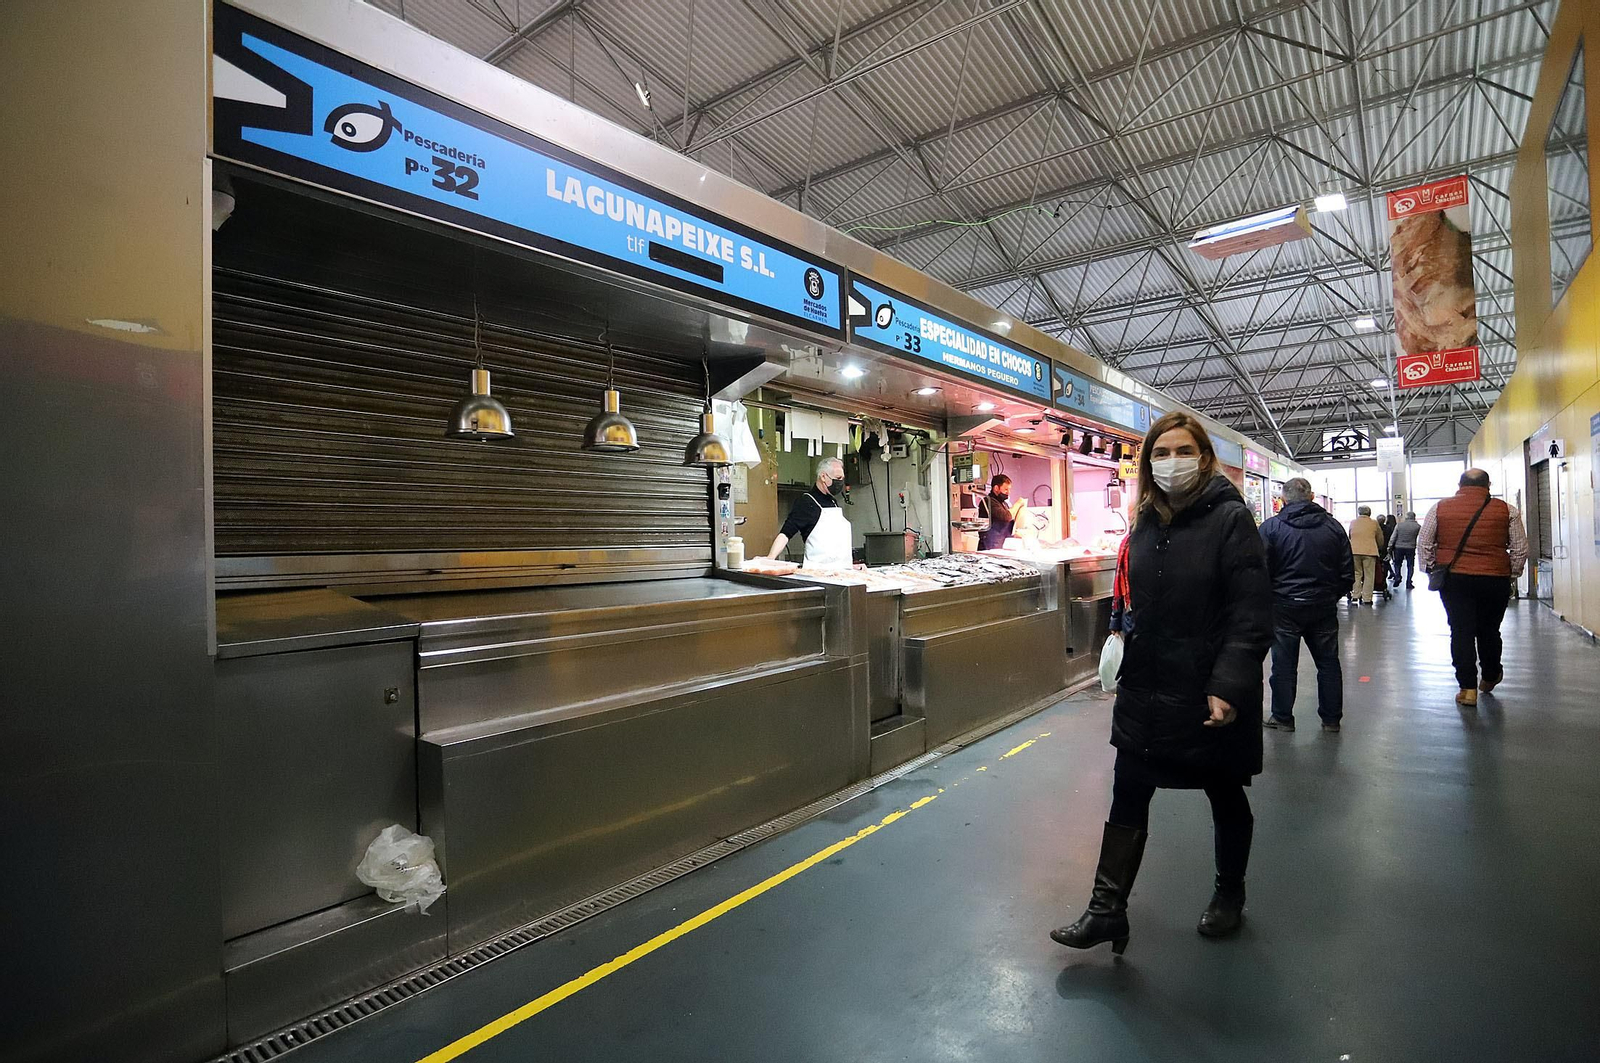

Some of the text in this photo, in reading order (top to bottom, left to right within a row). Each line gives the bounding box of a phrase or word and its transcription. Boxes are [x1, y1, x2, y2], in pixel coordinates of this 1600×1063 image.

[431, 155, 480, 201] 32
[546, 168, 775, 279] LAGUNAPEIXE S.L.
[626, 233, 645, 255] tlf
[904, 332, 921, 354] 33
[920, 317, 1032, 378] ESPECIALIDAD EN CHOCOS
[942, 351, 1019, 386] HERMANOS PEGUERO
